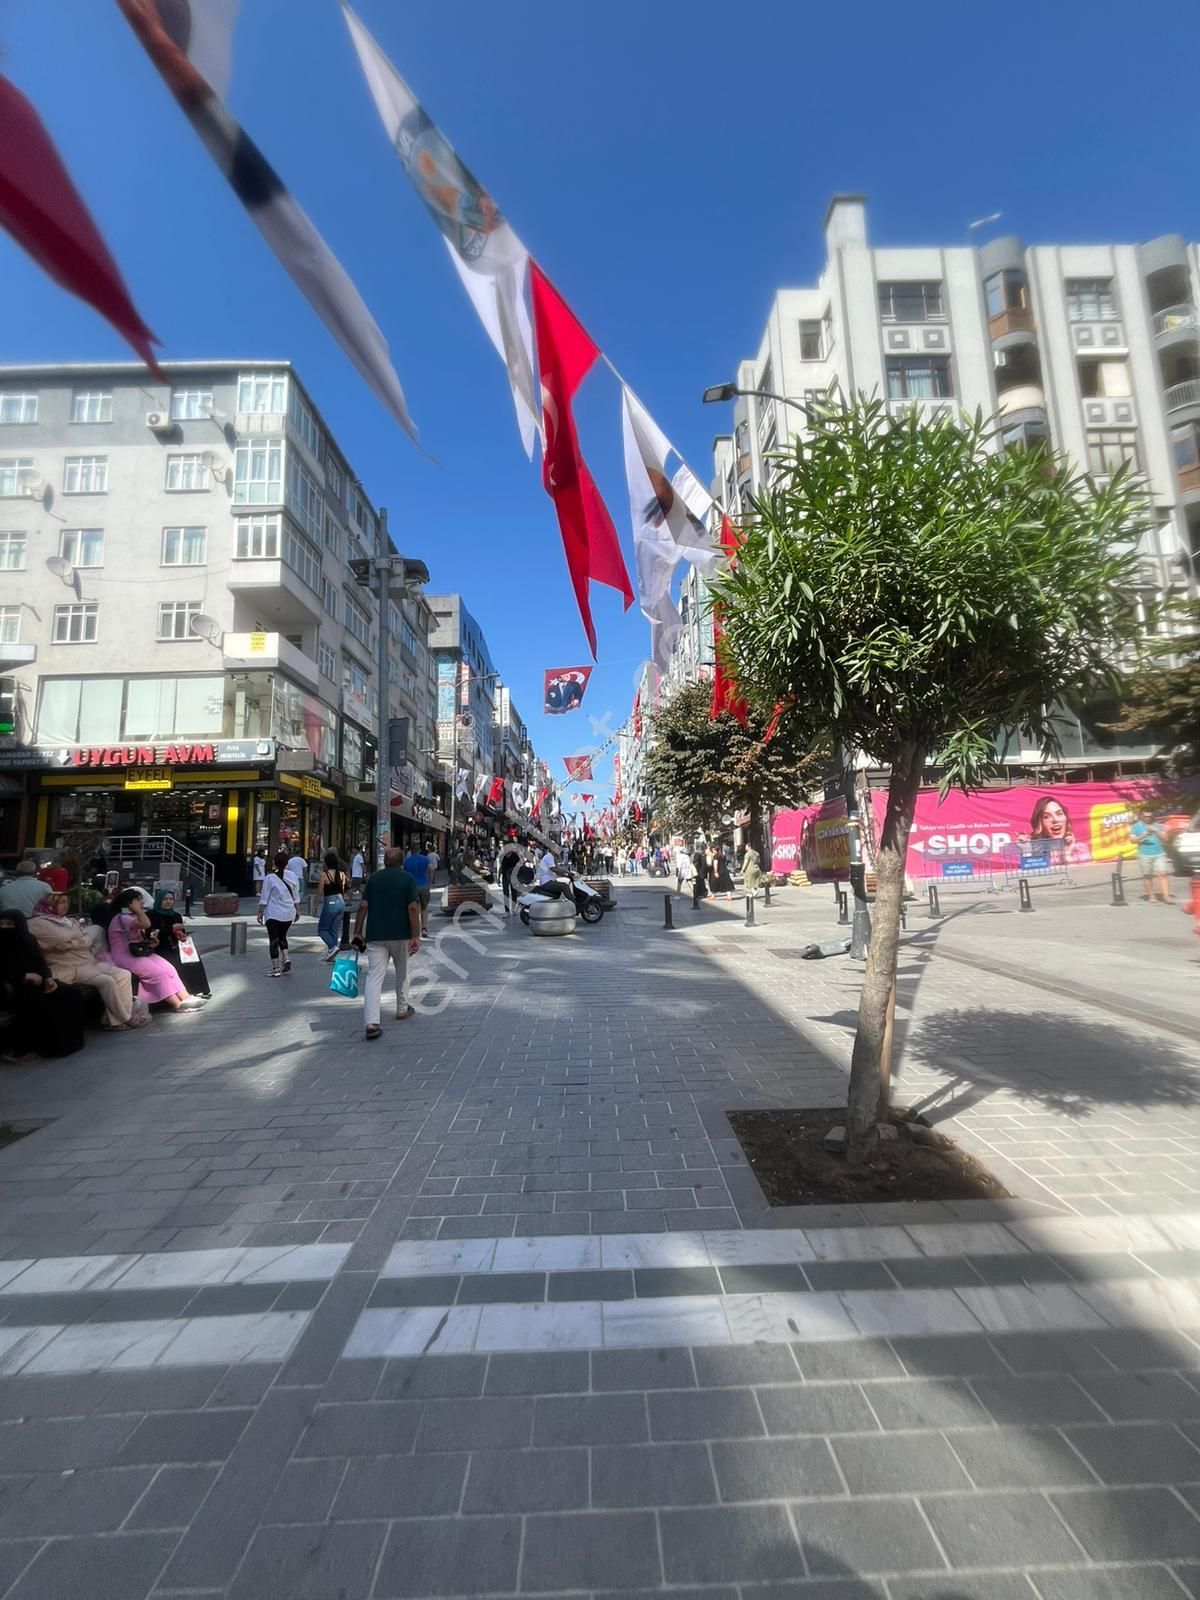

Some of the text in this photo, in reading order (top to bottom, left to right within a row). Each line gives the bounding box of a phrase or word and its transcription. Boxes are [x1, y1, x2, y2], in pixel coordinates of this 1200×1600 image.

[72, 743, 214, 766] UYGUN AVM
[128, 768, 168, 782] EYFEL
[303, 777, 320, 792] EYFEL
[777, 844, 797, 860] SHOP
[927, 833, 1011, 855] SHOP
